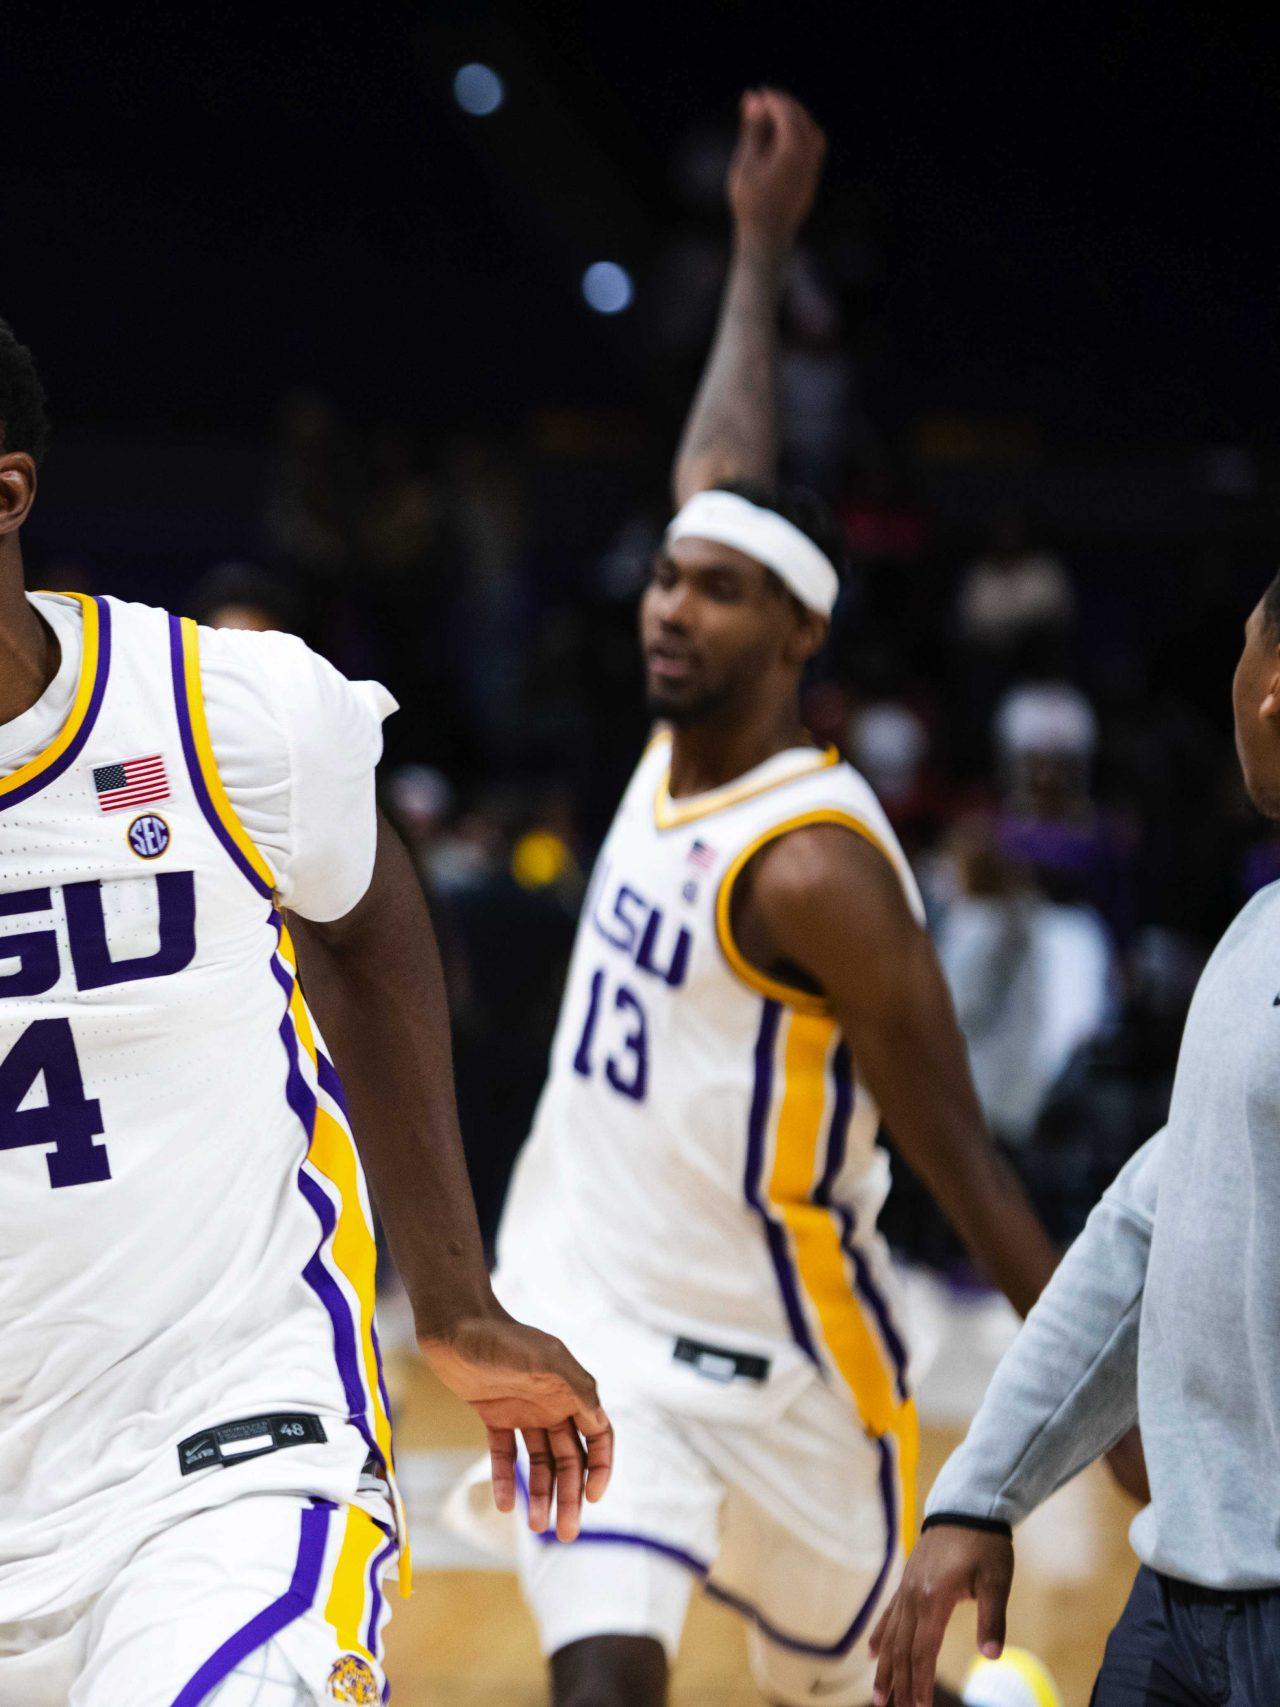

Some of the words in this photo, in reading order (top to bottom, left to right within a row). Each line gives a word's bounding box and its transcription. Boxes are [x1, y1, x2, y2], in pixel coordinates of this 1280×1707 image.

[129, 817, 168, 856] SEC
[592, 884, 691, 988] SU
[573, 968, 648, 1104] 13
[279, 1422, 306, 1438] 48
